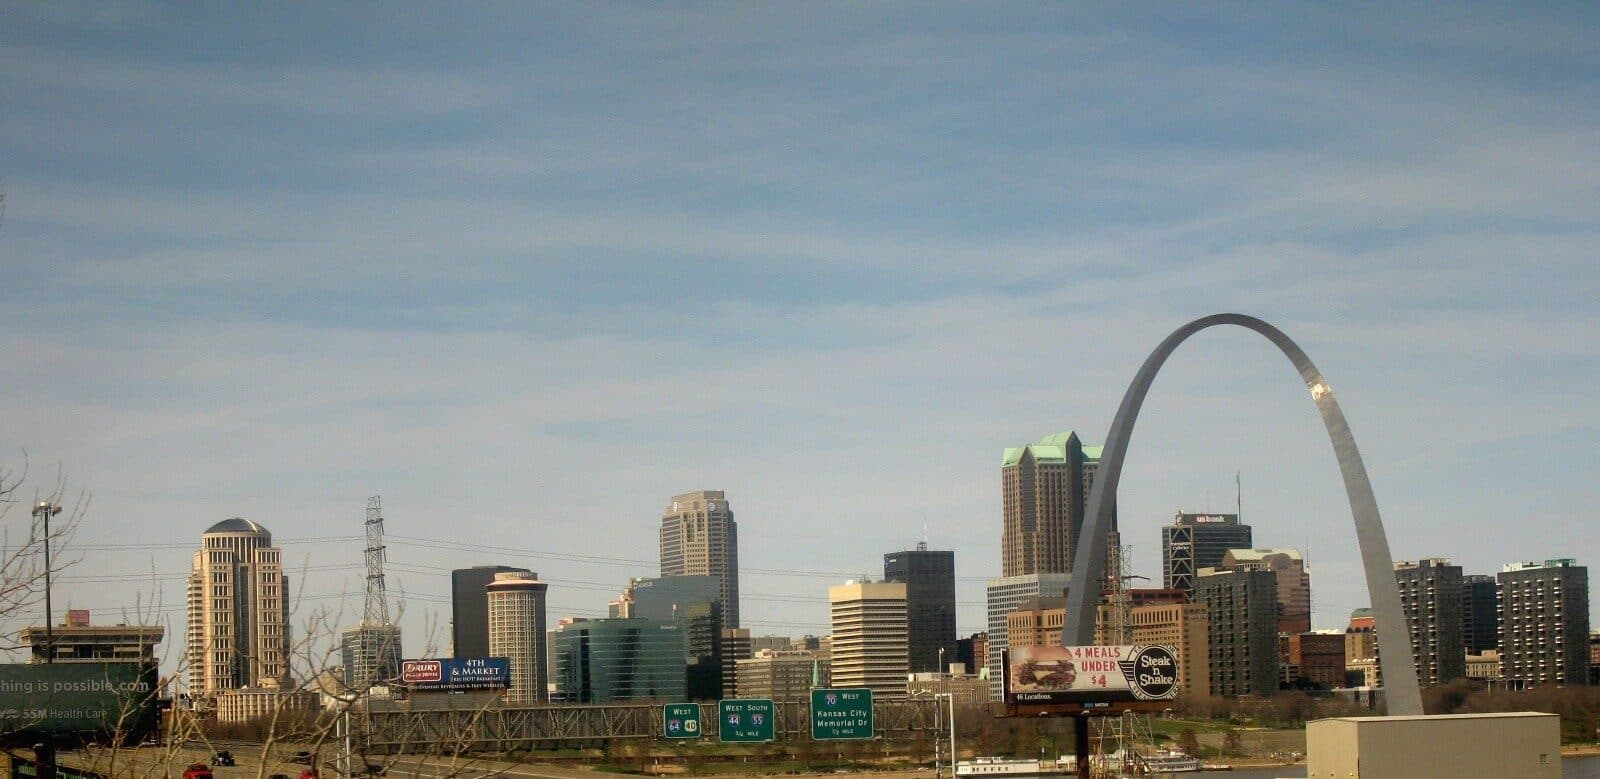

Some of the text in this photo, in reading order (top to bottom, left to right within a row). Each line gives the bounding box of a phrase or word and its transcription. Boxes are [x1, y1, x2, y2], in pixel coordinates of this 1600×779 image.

[1075, 647, 1081, 658] 4
[1085, 646, 1121, 658] MEALS
[466, 659, 485, 667] 4TH
[1081, 661, 1116, 672] UNDER
[1141, 655, 1171, 668] Steak
[452, 667, 500, 676] & MARKET
[1091, 674, 1107, 687] $4
[1140, 673, 1174, 686] Shake
[38, 680, 49, 691] is
[23, 707, 108, 719] SSM Health Care
[725, 704, 743, 712] WEST
[817, 709, 868, 718] Kansas City
[668, 720, 695, 731] 64 40
[728, 717, 763, 726] 44 55
[817, 719, 855, 727] Memorial
